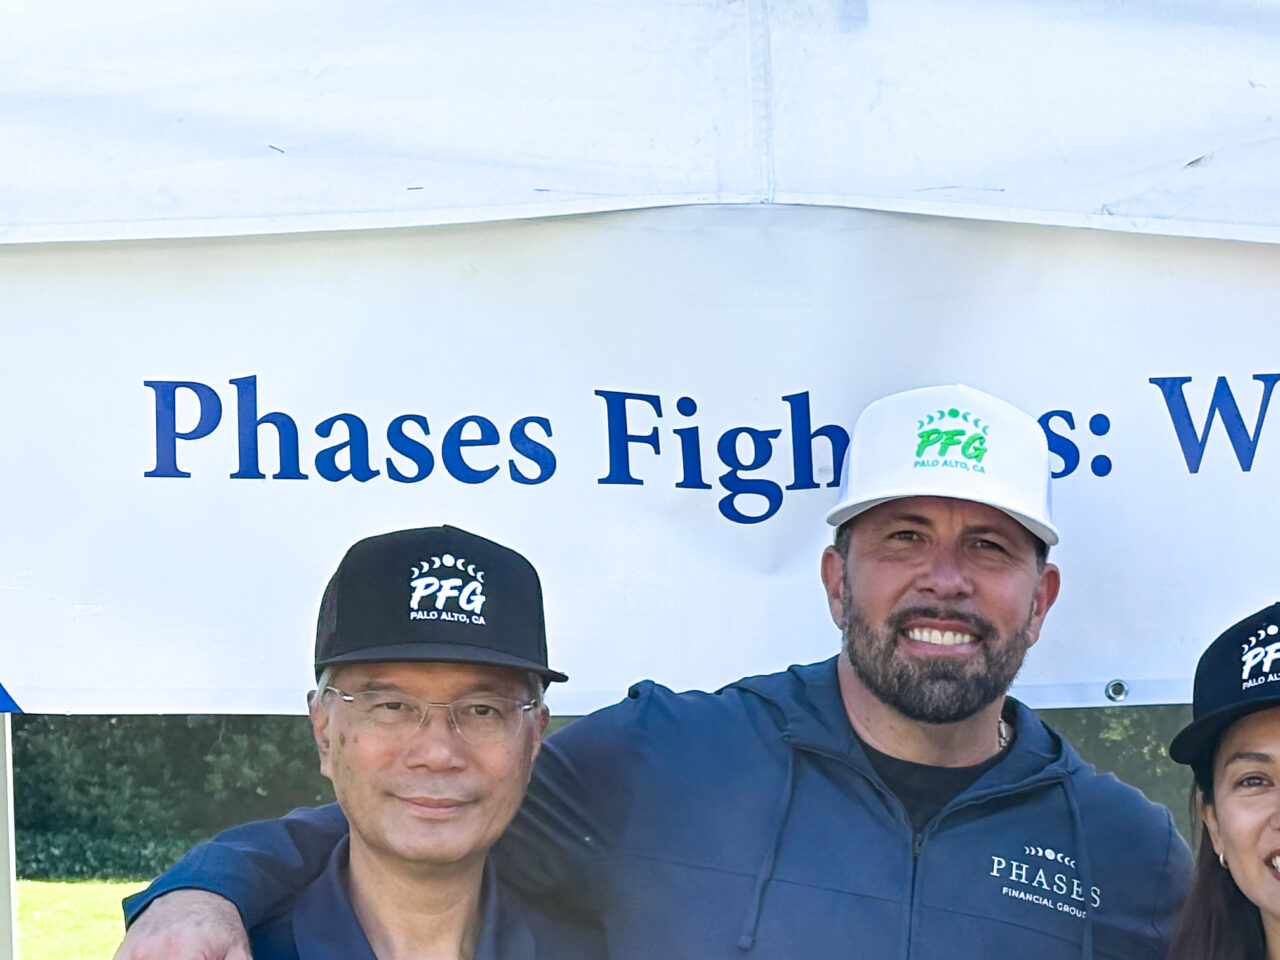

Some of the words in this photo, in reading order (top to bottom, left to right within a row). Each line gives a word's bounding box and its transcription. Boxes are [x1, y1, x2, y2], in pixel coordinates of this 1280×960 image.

[143, 374, 558, 485] Phases
[594, 389, 1113, 524] Fighs:
[916, 428, 988, 463] PFG
[913, 459, 940, 468] PALO
[941, 460, 970, 471] ALTO,
[972, 464, 986, 474] CA
[410, 576, 486, 614] PFG
[410, 611, 438, 620] PALO
[440, 612, 470, 624] ALTO,
[471, 615, 486, 625] CA
[1242, 676, 1266, 690] PALO
[989, 856, 1101, 908] PHASES
[1002, 886, 1055, 909] FINANCIAL
